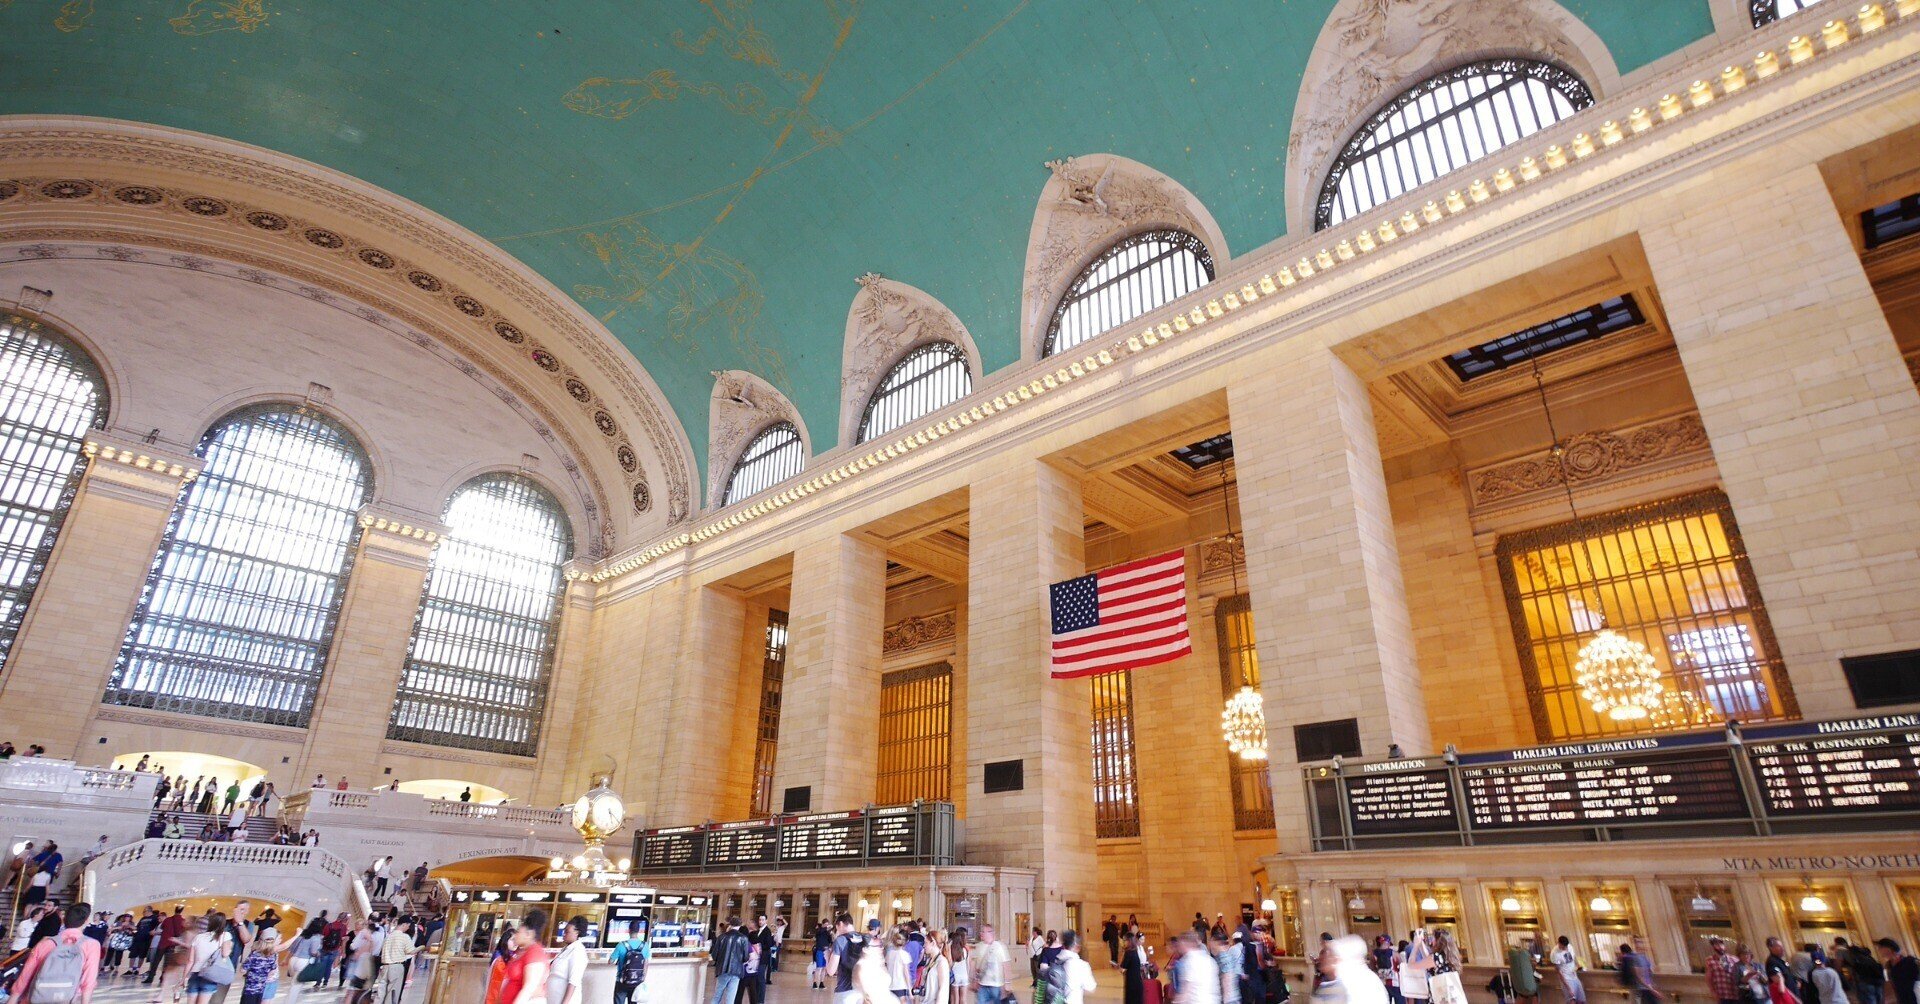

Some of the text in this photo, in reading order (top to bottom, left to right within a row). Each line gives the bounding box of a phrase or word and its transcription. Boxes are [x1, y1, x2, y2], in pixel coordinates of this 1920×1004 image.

[1818, 714, 1920, 733] HARLEM LINE
[1513, 738, 1658, 760] HARLEM LINE DEPARTURES
[1752, 745, 1778, 754] TIME
[1784, 742, 1808, 752] TRK
[1814, 735, 1890, 750] DESTINATION
[1817, 750, 1864, 761] SOUTHEAST
[1364, 759, 1426, 772] INFORMATION
[1508, 762, 1562, 774] DESTINATION
[1573, 758, 1615, 769] REMARKS
[1835, 761, 1863, 771] WHITE
[1866, 759, 1901, 770] PLAINS
[1521, 774, 1541, 783] WHITE
[1542, 772, 1567, 782] PLAINS
[1615, 768, 1627, 776] 1ST
[1630, 766, 1649, 775] STOP
[1824, 772, 1872, 784] SOUTHEAST
[1366, 777, 1395, 785] Attention
[1512, 784, 1546, 793] SOUTHEAST
[1577, 780, 1599, 789] WHITE
[1601, 778, 1627, 787] PLAINS
[1637, 776, 1650, 785] 1ST
[1653, 774, 1672, 784] STOP
[1368, 786, 1383, 794] leave
[1386, 785, 1411, 794] packages
[1413, 782, 1445, 791] unattended
[1525, 793, 1545, 802] WHITE
[1547, 791, 1571, 800] PLAINS
[1620, 788, 1632, 796] 1ST
[1636, 786, 1654, 795] STOP
[1843, 783, 1871, 794] WHITE
[1874, 782, 1909, 793] PLAINS
[1384, 793, 1400, 801] items
[1402, 793, 1412, 801] may
[1832, 795, 1880, 807] SOUTHEAST
[1391, 802, 1411, 810] Police
[1412, 800, 1445, 809] Department
[1516, 802, 1550, 812] SOUTHEAST
[1583, 800, 1604, 809] WHITE
[1606, 797, 1632, 807] PLAINS
[1642, 796, 1656, 805] 1ST
[1658, 795, 1678, 804] STOP
[1357, 809, 1451, 821] Thank you for your cooperation
[1529, 812, 1549, 821] WHITE
[1551, 810, 1575, 820] PLAINS
[1625, 808, 1638, 817] 1ST
[1641, 806, 1659, 816] STOP
[376, 839, 406, 847] BALCONY
[458, 847, 502, 859] LEXINGTON
[1722, 854, 1920, 871] MTA METRO-NORTH
[148, 890, 176, 901] TRACKS
[245, 889, 270, 897] DINING
